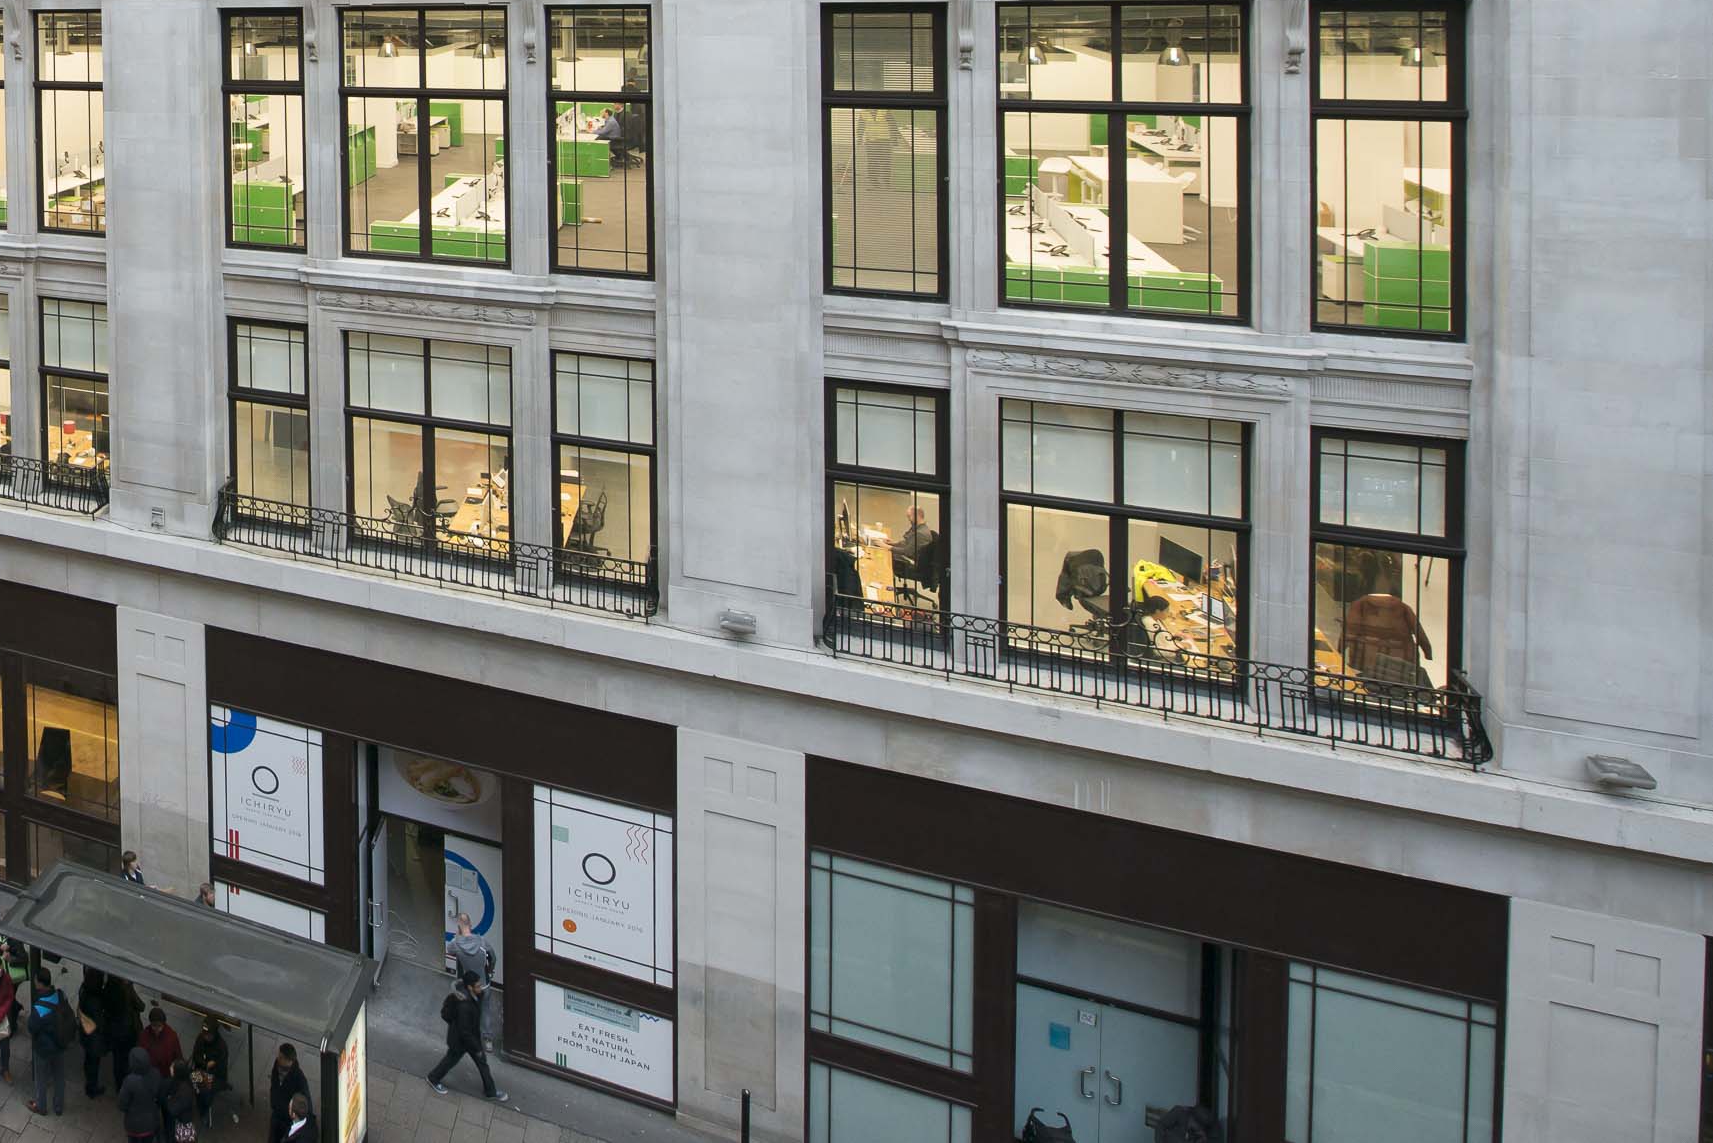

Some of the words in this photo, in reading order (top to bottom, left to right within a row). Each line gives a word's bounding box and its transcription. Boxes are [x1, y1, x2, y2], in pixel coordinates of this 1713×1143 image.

[240, 796, 292, 818] ICHIRYU
[568, 886, 630, 910] ICHIRYU
[571, 1031, 589, 1042] EAT
[592, 1038, 636, 1056] NATURAL
[578, 1023, 596, 1034] EAT
[598, 1029, 629, 1044] FRESH
[557, 1036, 583, 1050] FROM
[585, 1045, 617, 1060] SOUTH
[619, 1056, 651, 1071] JAPAN
